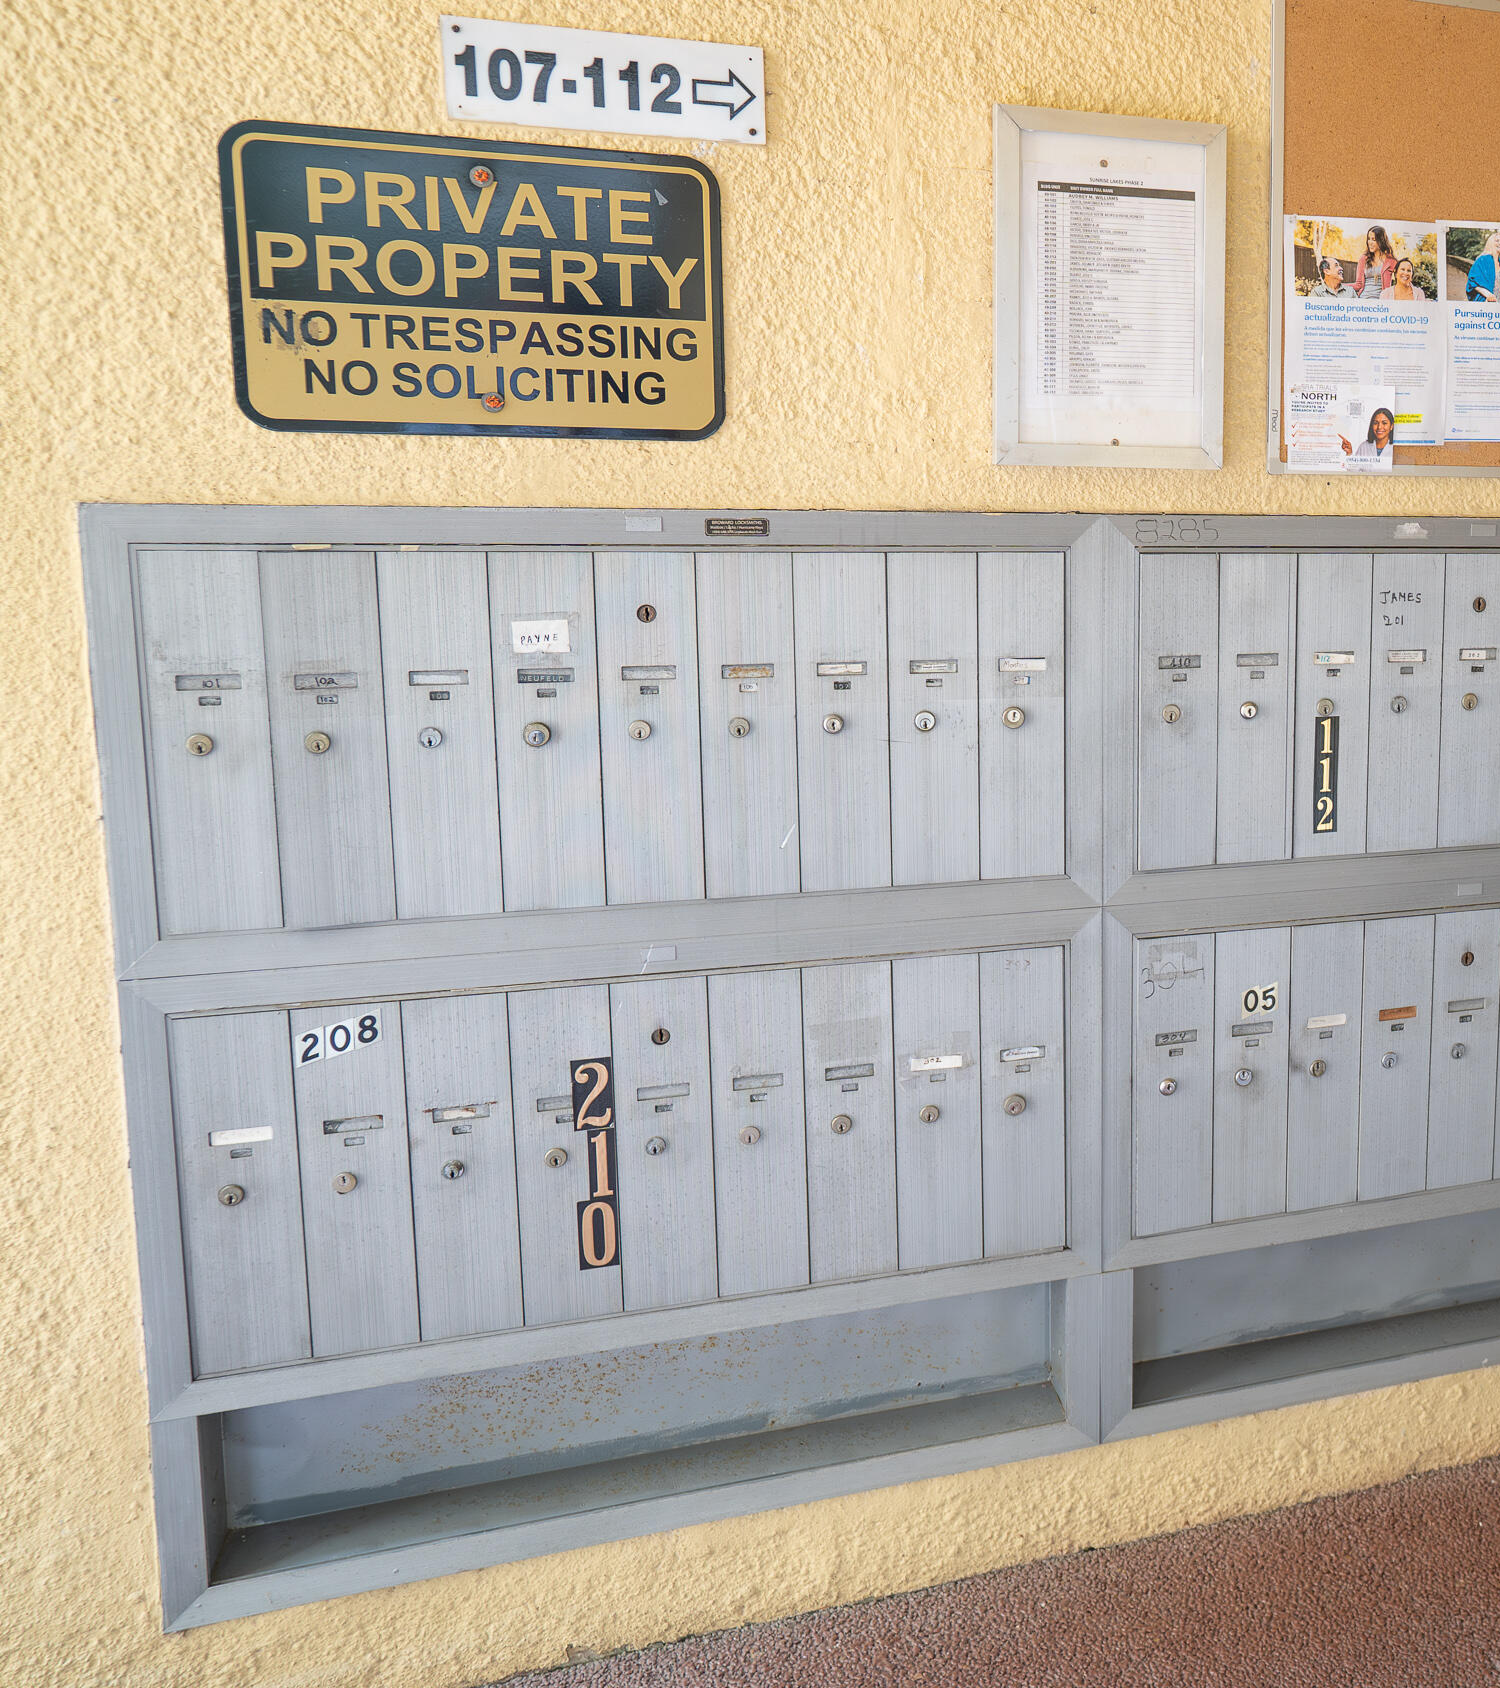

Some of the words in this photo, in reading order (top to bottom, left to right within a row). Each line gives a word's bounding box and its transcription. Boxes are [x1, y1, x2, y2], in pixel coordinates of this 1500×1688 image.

[455, 45, 682, 115] 107-112
[304, 167, 653, 245] PRIVATE
[255, 231, 699, 310] PROPERTY
[1304, 302, 1345, 311] Buscando
[1346, 304, 1389, 314] protección
[1454, 308, 1493, 320] Pursuing
[1304, 313, 1351, 322] actualizada
[1380, 315, 1388, 323] el
[1389, 316, 1429, 325] COVID-19
[1454, 321, 1486, 331] against
[261, 308, 338, 347] NO
[350, 313, 699, 361] TRESPASSING
[304, 359, 379, 396] NO
[392, 363, 666, 405] SOLICITING
[1301, 392, 1337, 401] NORTH
[1379, 590, 1422, 604] JAMES
[1383, 615, 1404, 626] 201
[520, 633, 559, 645] PAYNE
[202, 678, 220, 689] 101
[520, 674, 565, 682] NEUFELD
[1316, 717, 1334, 832] 112
[1243, 986, 1276, 1013] 05
[301, 1014, 379, 1064] 208
[574, 1061, 616, 1267] 210
